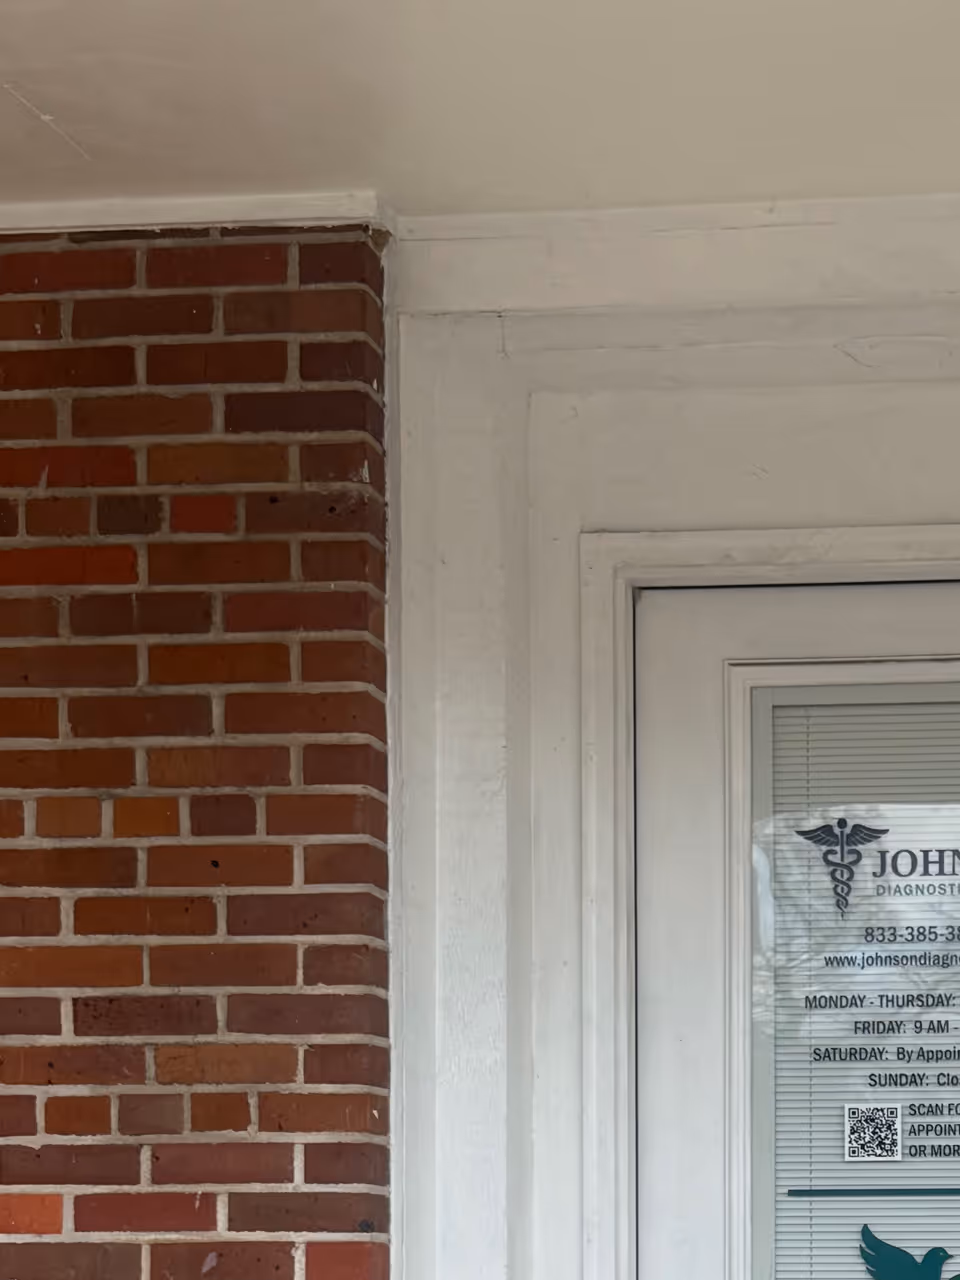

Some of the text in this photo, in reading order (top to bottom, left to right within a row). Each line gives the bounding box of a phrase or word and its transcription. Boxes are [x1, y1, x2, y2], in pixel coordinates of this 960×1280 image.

[804, 995, 866, 1009] MONDAY
[878, 993, 956, 1008] THURSDAY:
[854, 1020, 906, 1034] FRIDAY:
[914, 1020, 923, 1034] 9
[927, 1020, 949, 1034] AM
[812, 1047, 889, 1061] SATURDAY:
[896, 1046, 914, 1063] By
[868, 1072, 929, 1087] SUNDAY:
[908, 1103, 944, 1117] SCAN
[908, 1145, 928, 1158] OR
